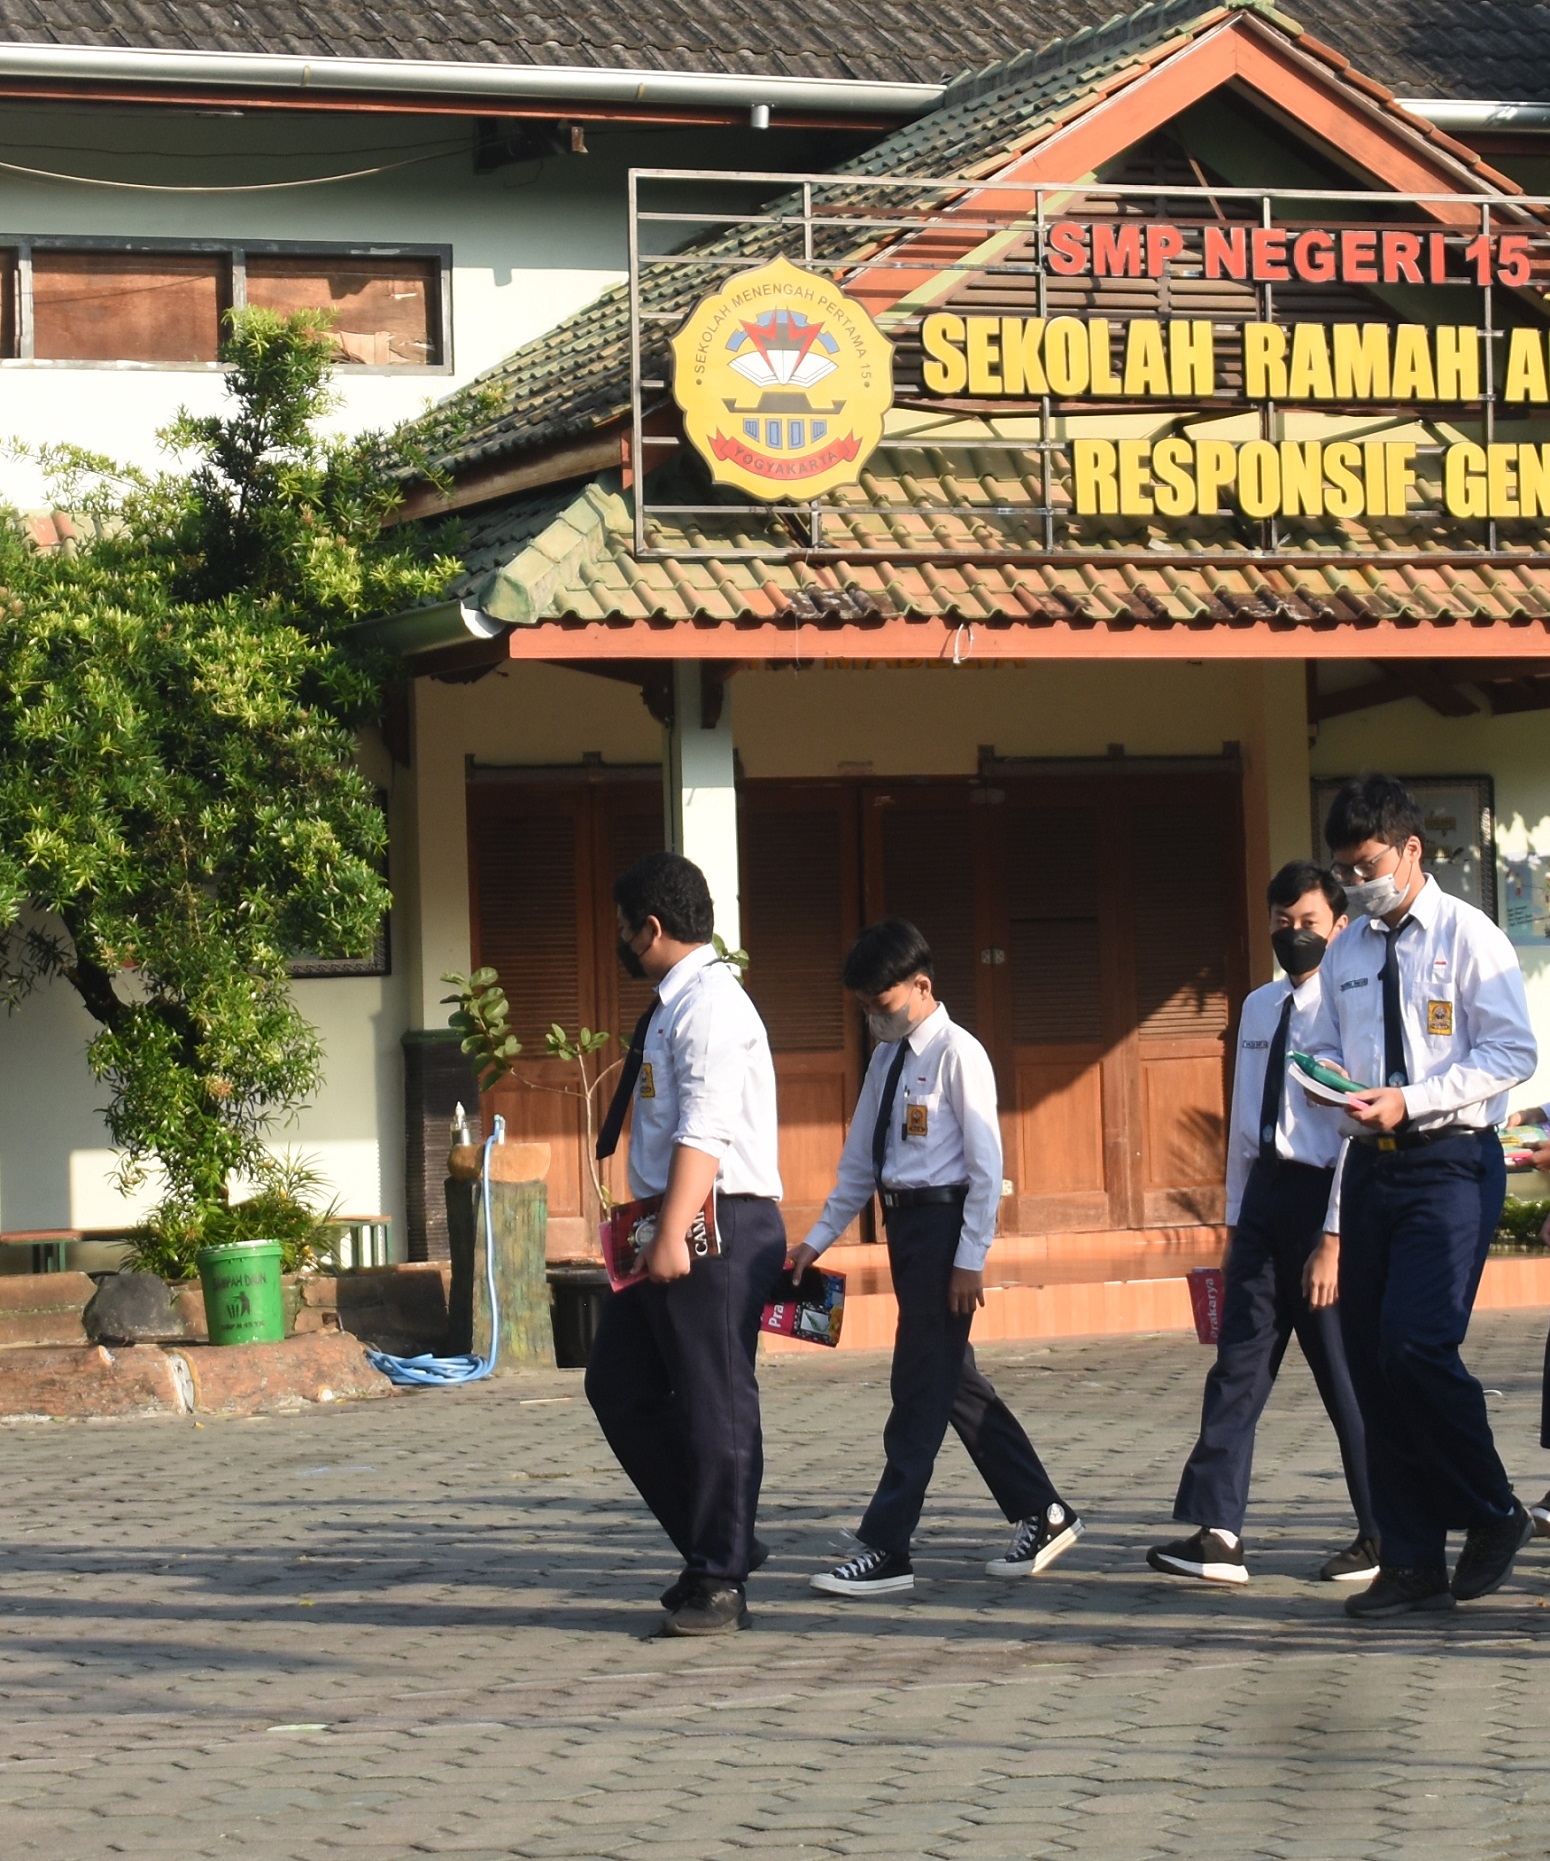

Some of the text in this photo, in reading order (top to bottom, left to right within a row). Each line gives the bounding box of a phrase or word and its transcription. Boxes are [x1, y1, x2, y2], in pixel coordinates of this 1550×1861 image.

[1048, 222, 1183, 279] SMP
[1205, 227, 1446, 286] NEGERI
[1465, 233, 1531, 287] 15
[694, 282, 873, 380] SEKOLAH MENENGAH PERTAMA 15
[922, 312, 1215, 398] SEKOLAH
[1244, 322, 1480, 402] RAMAH
[734, 446, 838, 475] YOGYAKARTA
[1073, 438, 1418, 519] RESPONSIF
